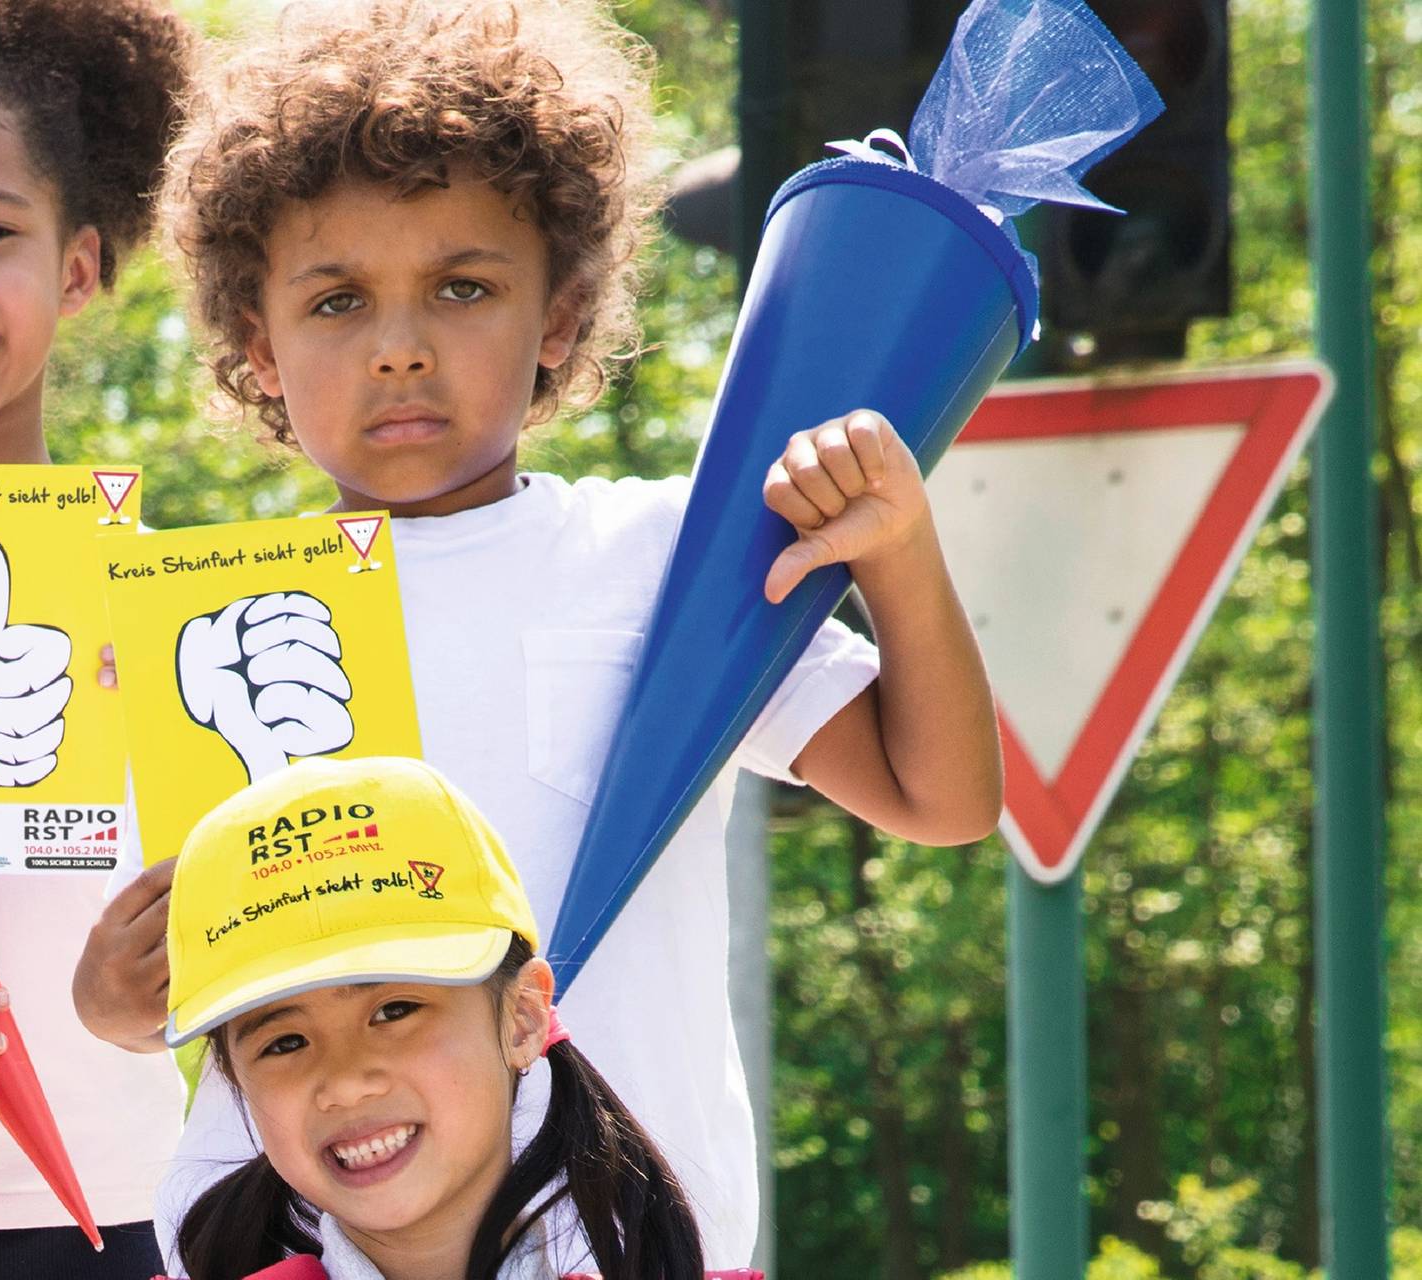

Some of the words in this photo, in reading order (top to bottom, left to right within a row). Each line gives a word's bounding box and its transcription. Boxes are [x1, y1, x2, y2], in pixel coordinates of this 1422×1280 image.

[9, 486, 50, 503] sieht
[57, 486, 96, 509] gelb!
[108, 562, 156, 580] Kreis
[162, 551, 247, 575] Steinfurt
[254, 541, 296, 562] sieht
[304, 534, 343, 563] gelb!
[24, 809, 116, 823] RADIO
[248, 804, 374, 846] RADIO
[24, 826, 73, 840] RST
[251, 833, 312, 865] RST
[25, 846, 52, 854] 104.0
[63, 846, 90, 855] 105.2
[93, 847, 117, 855] MHz
[252, 859, 292, 880] 104.0
[306, 847, 347, 864] 105.2
[350, 842, 384, 853] MHz
[206, 916, 241, 947] Kreis
[243, 885, 311, 921] Steinfurt
[316, 872, 363, 896] sieht
[372, 871, 414, 893] gelb!
